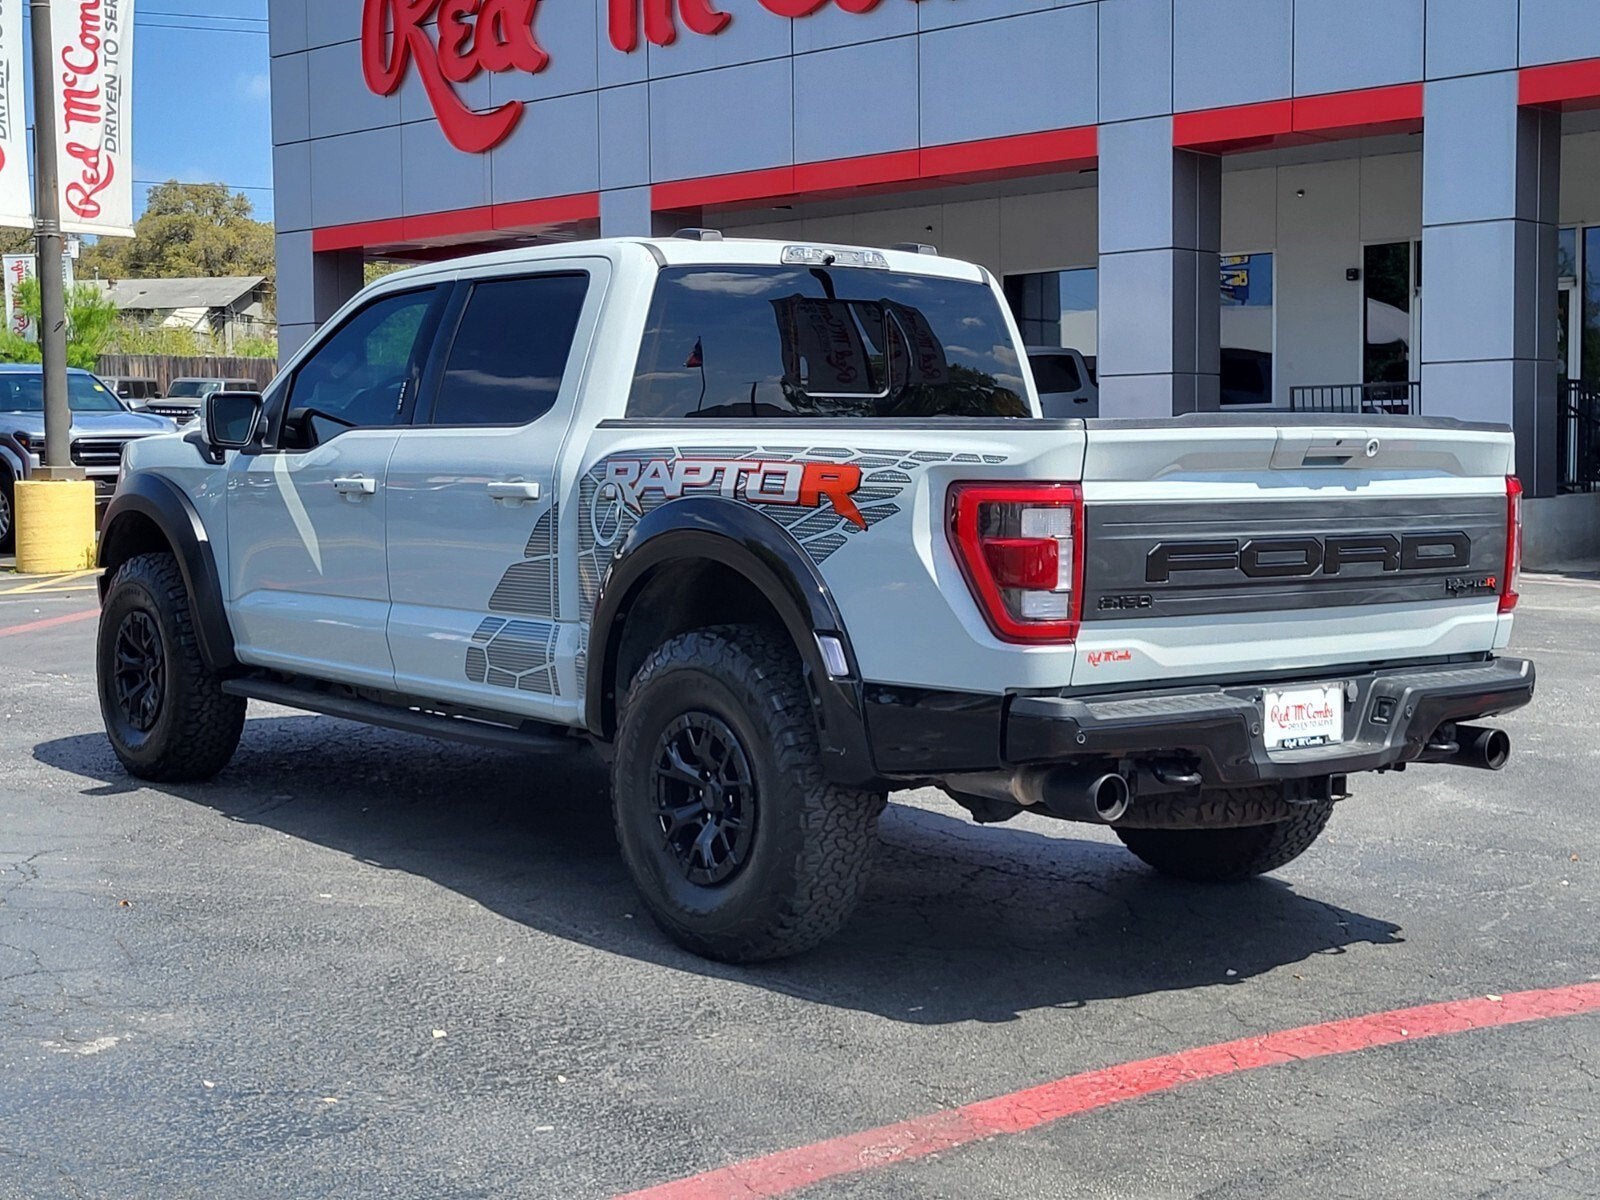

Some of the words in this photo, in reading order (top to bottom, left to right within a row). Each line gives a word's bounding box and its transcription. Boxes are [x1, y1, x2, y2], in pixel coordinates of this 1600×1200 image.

[103, 38, 119, 67] TO
[104, 73, 117, 154] DRIVEN
[66, 142, 115, 218] Red
[604, 457, 869, 532] RAPTOR
[1146, 531, 1471, 583] FORD
[1445, 576, 1497, 594] RAPTOR
[1087, 651, 1102, 667] Red
[1271, 705, 1289, 728] Red
